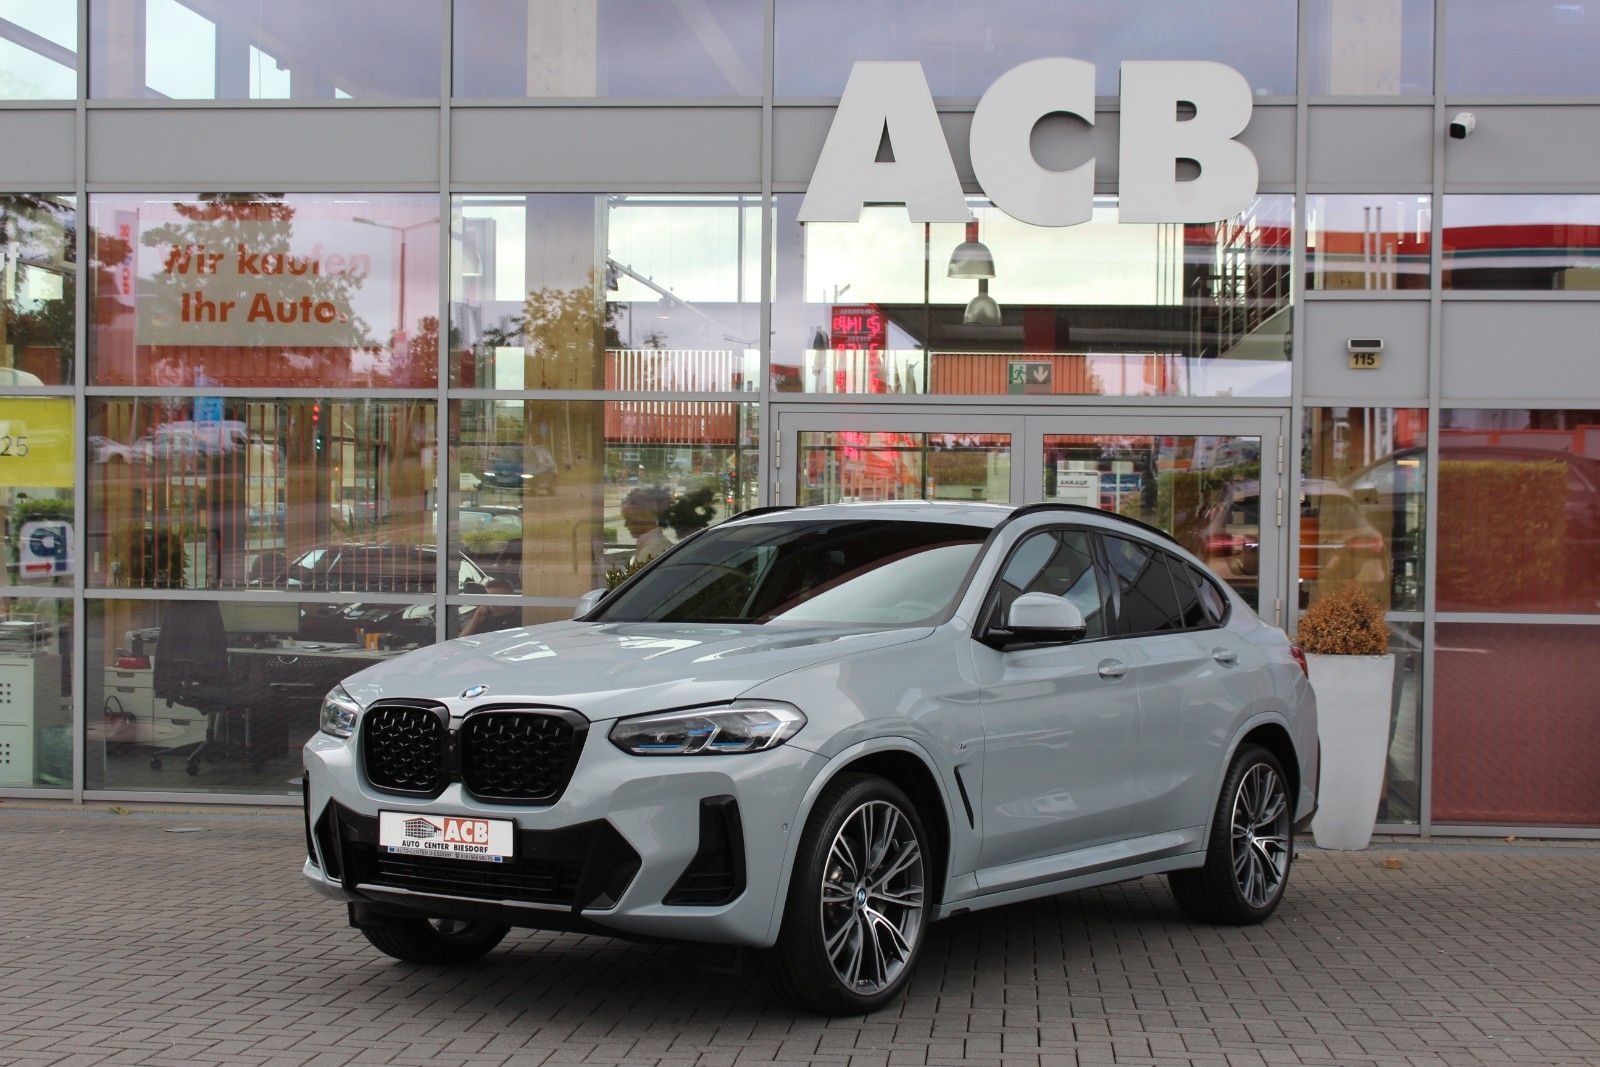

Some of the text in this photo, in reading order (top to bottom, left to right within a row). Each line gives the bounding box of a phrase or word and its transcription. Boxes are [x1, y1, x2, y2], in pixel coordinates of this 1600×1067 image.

[797, 57, 1259, 227] ACB
[157, 244, 224, 276] Wir
[237, 243, 371, 277] kaufen
[181, 291, 348, 323] Ihr Auto.
[1352, 352, 1375, 366] 115
[444, 820, 488, 844] ACB
[402, 840, 488, 853] AUTO CENTER BIESDORF
